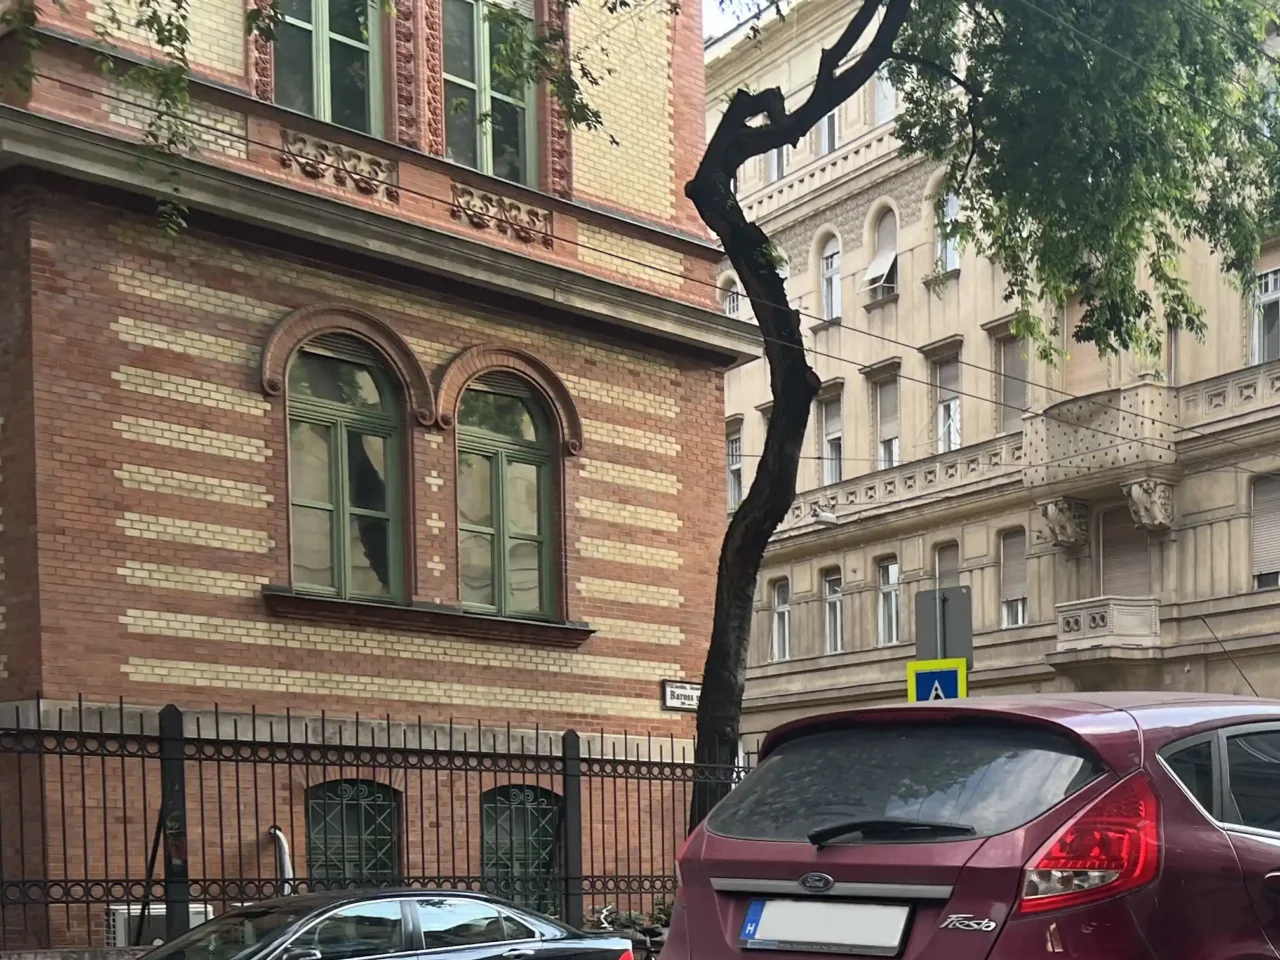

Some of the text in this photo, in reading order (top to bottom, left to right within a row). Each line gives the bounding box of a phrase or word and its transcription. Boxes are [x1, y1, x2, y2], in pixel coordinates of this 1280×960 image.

[670, 690, 694, 702] Baross
[745, 922, 756, 934] H
[939, 914, 997, 931] Fiesta
